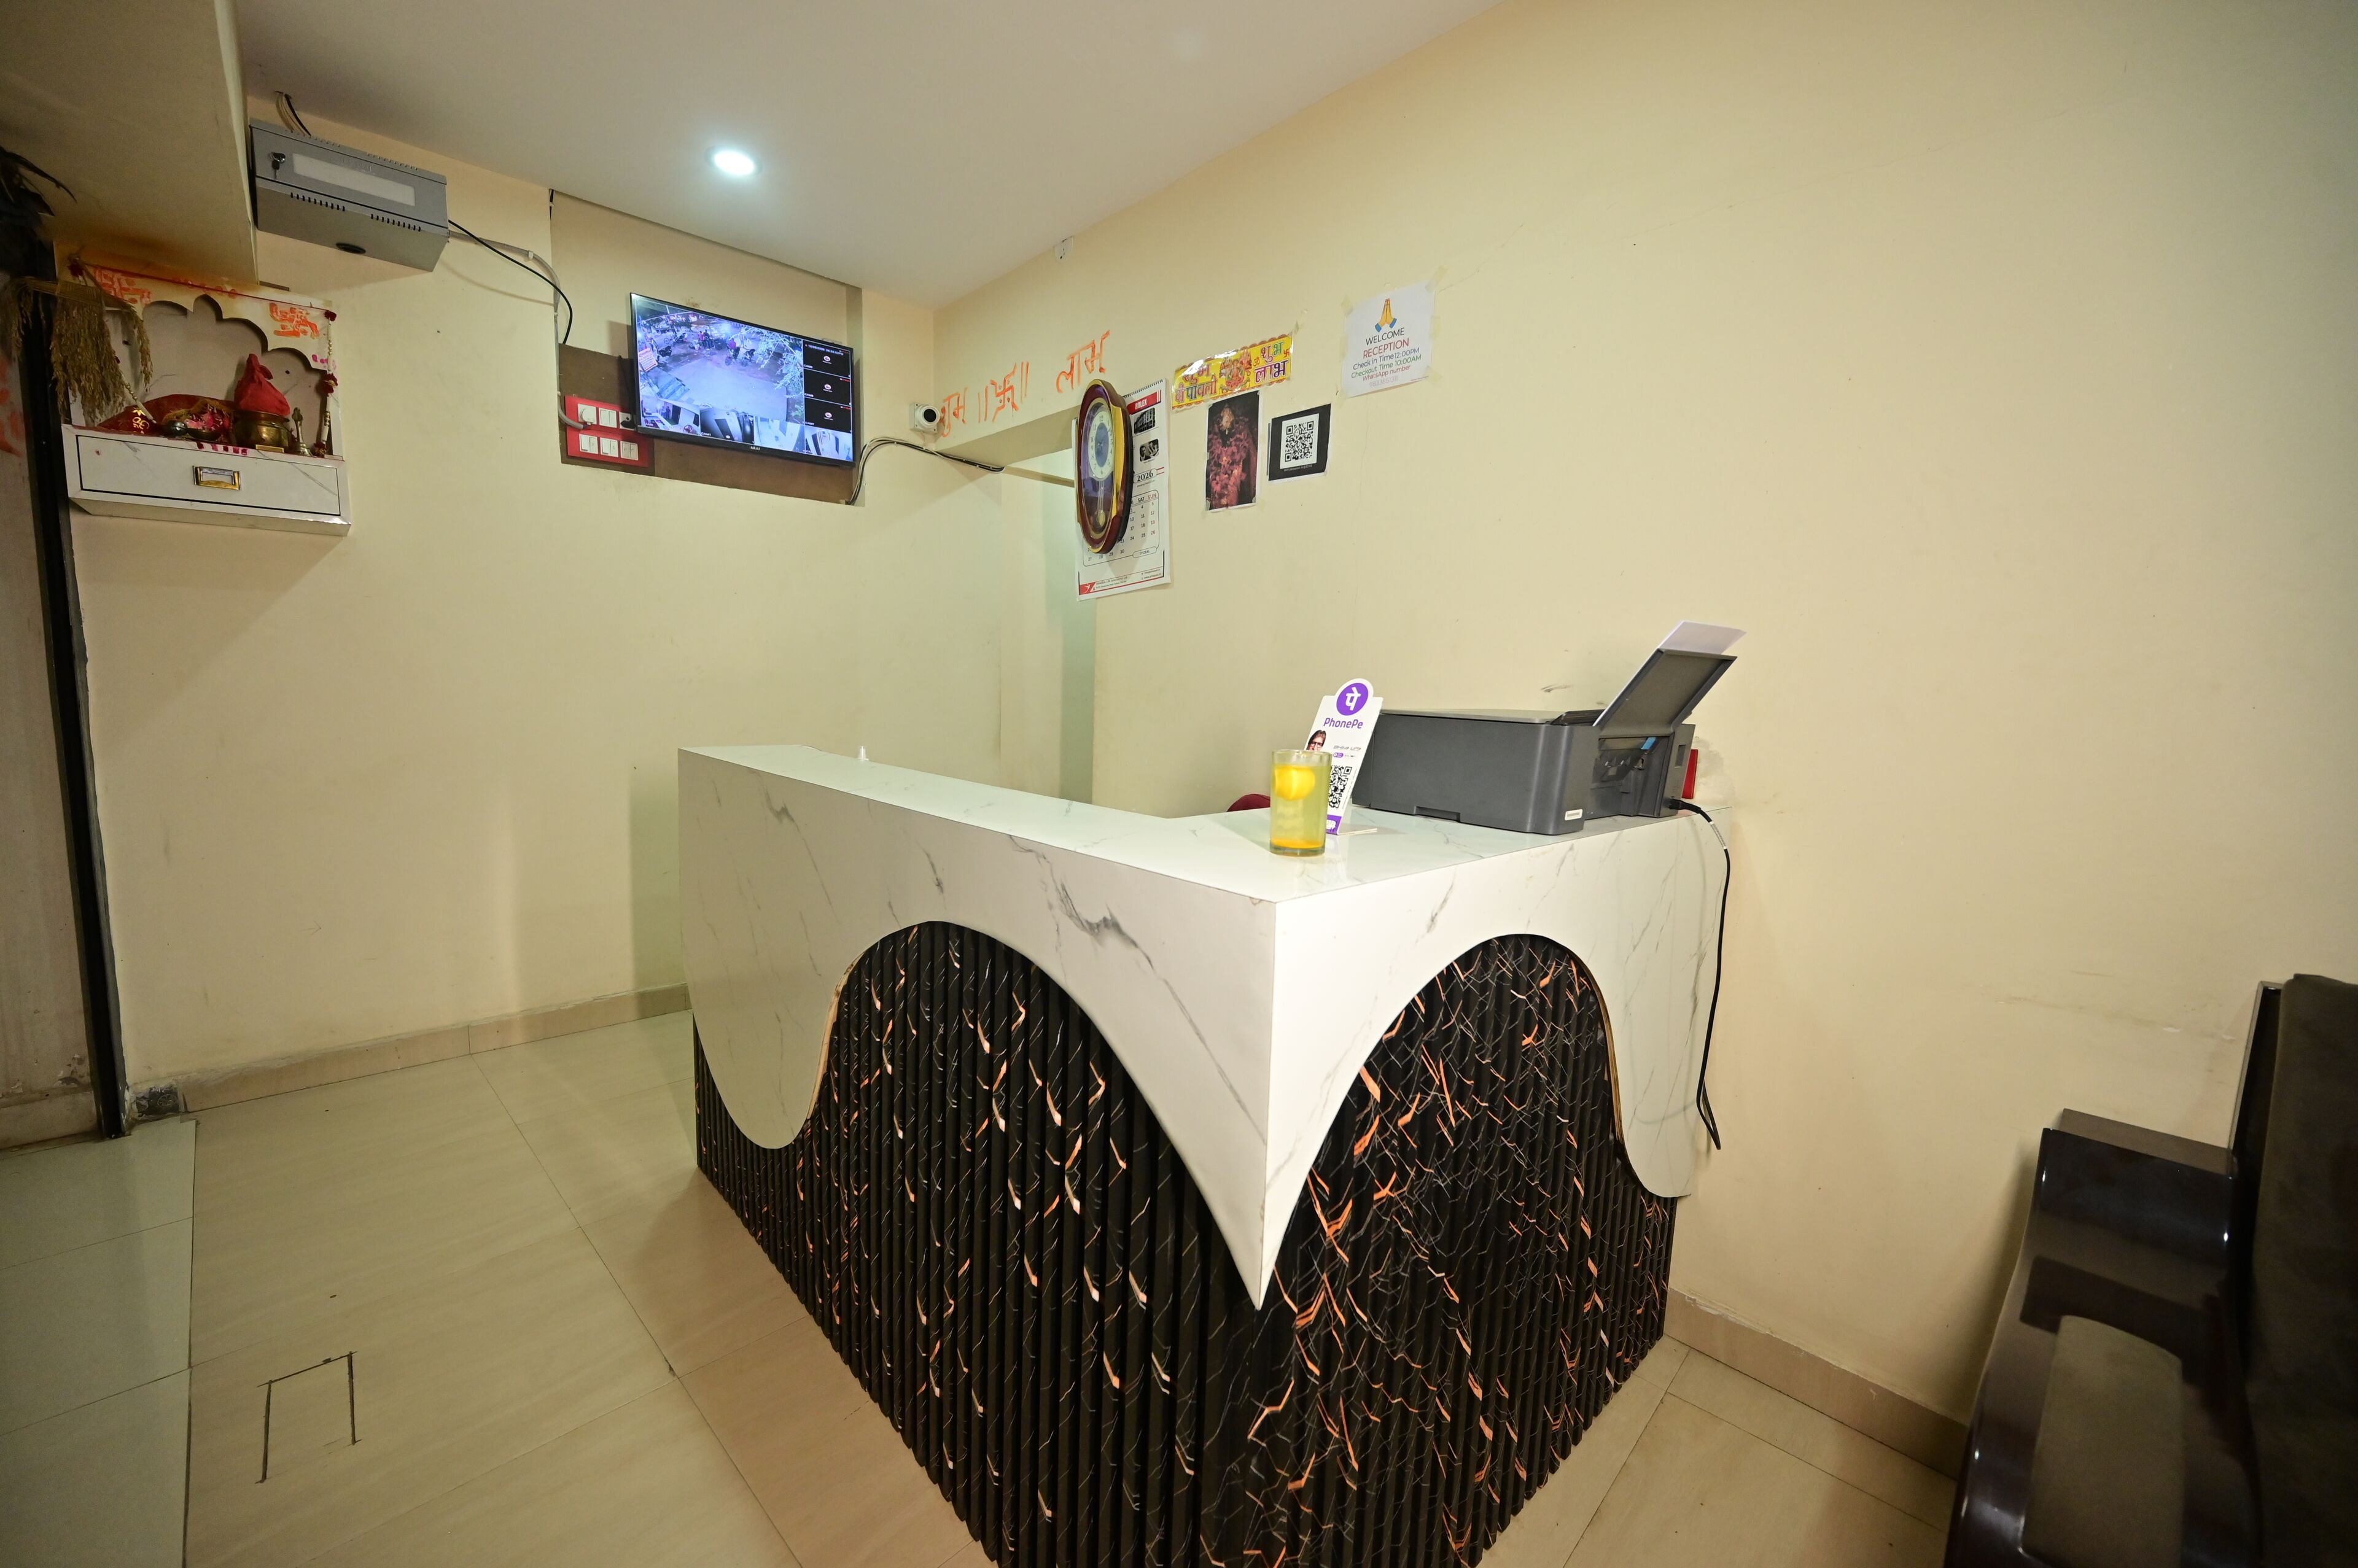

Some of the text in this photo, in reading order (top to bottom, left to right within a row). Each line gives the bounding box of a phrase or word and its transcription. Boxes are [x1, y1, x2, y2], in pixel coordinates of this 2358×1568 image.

[1366, 327, 1405, 346] WELCOME
[1261, 341, 1284, 362] शुभ
[1353, 359, 1371, 370] Check
[1379, 354, 1394, 363] Time
[1395, 347, 1420, 359] 12:00PM
[1363, 338, 1409, 359] RECEPTION
[1254, 360, 1288, 384] लाभ
[1351, 354, 1422, 378] Checkout Time 10:00AM
[1362, 365, 1411, 381] WhatsApp number
[1135, 398, 1147, 410] ROLEX
[1137, 471, 1153, 482] 2026
[1323, 717, 1363, 729] PhonePe
